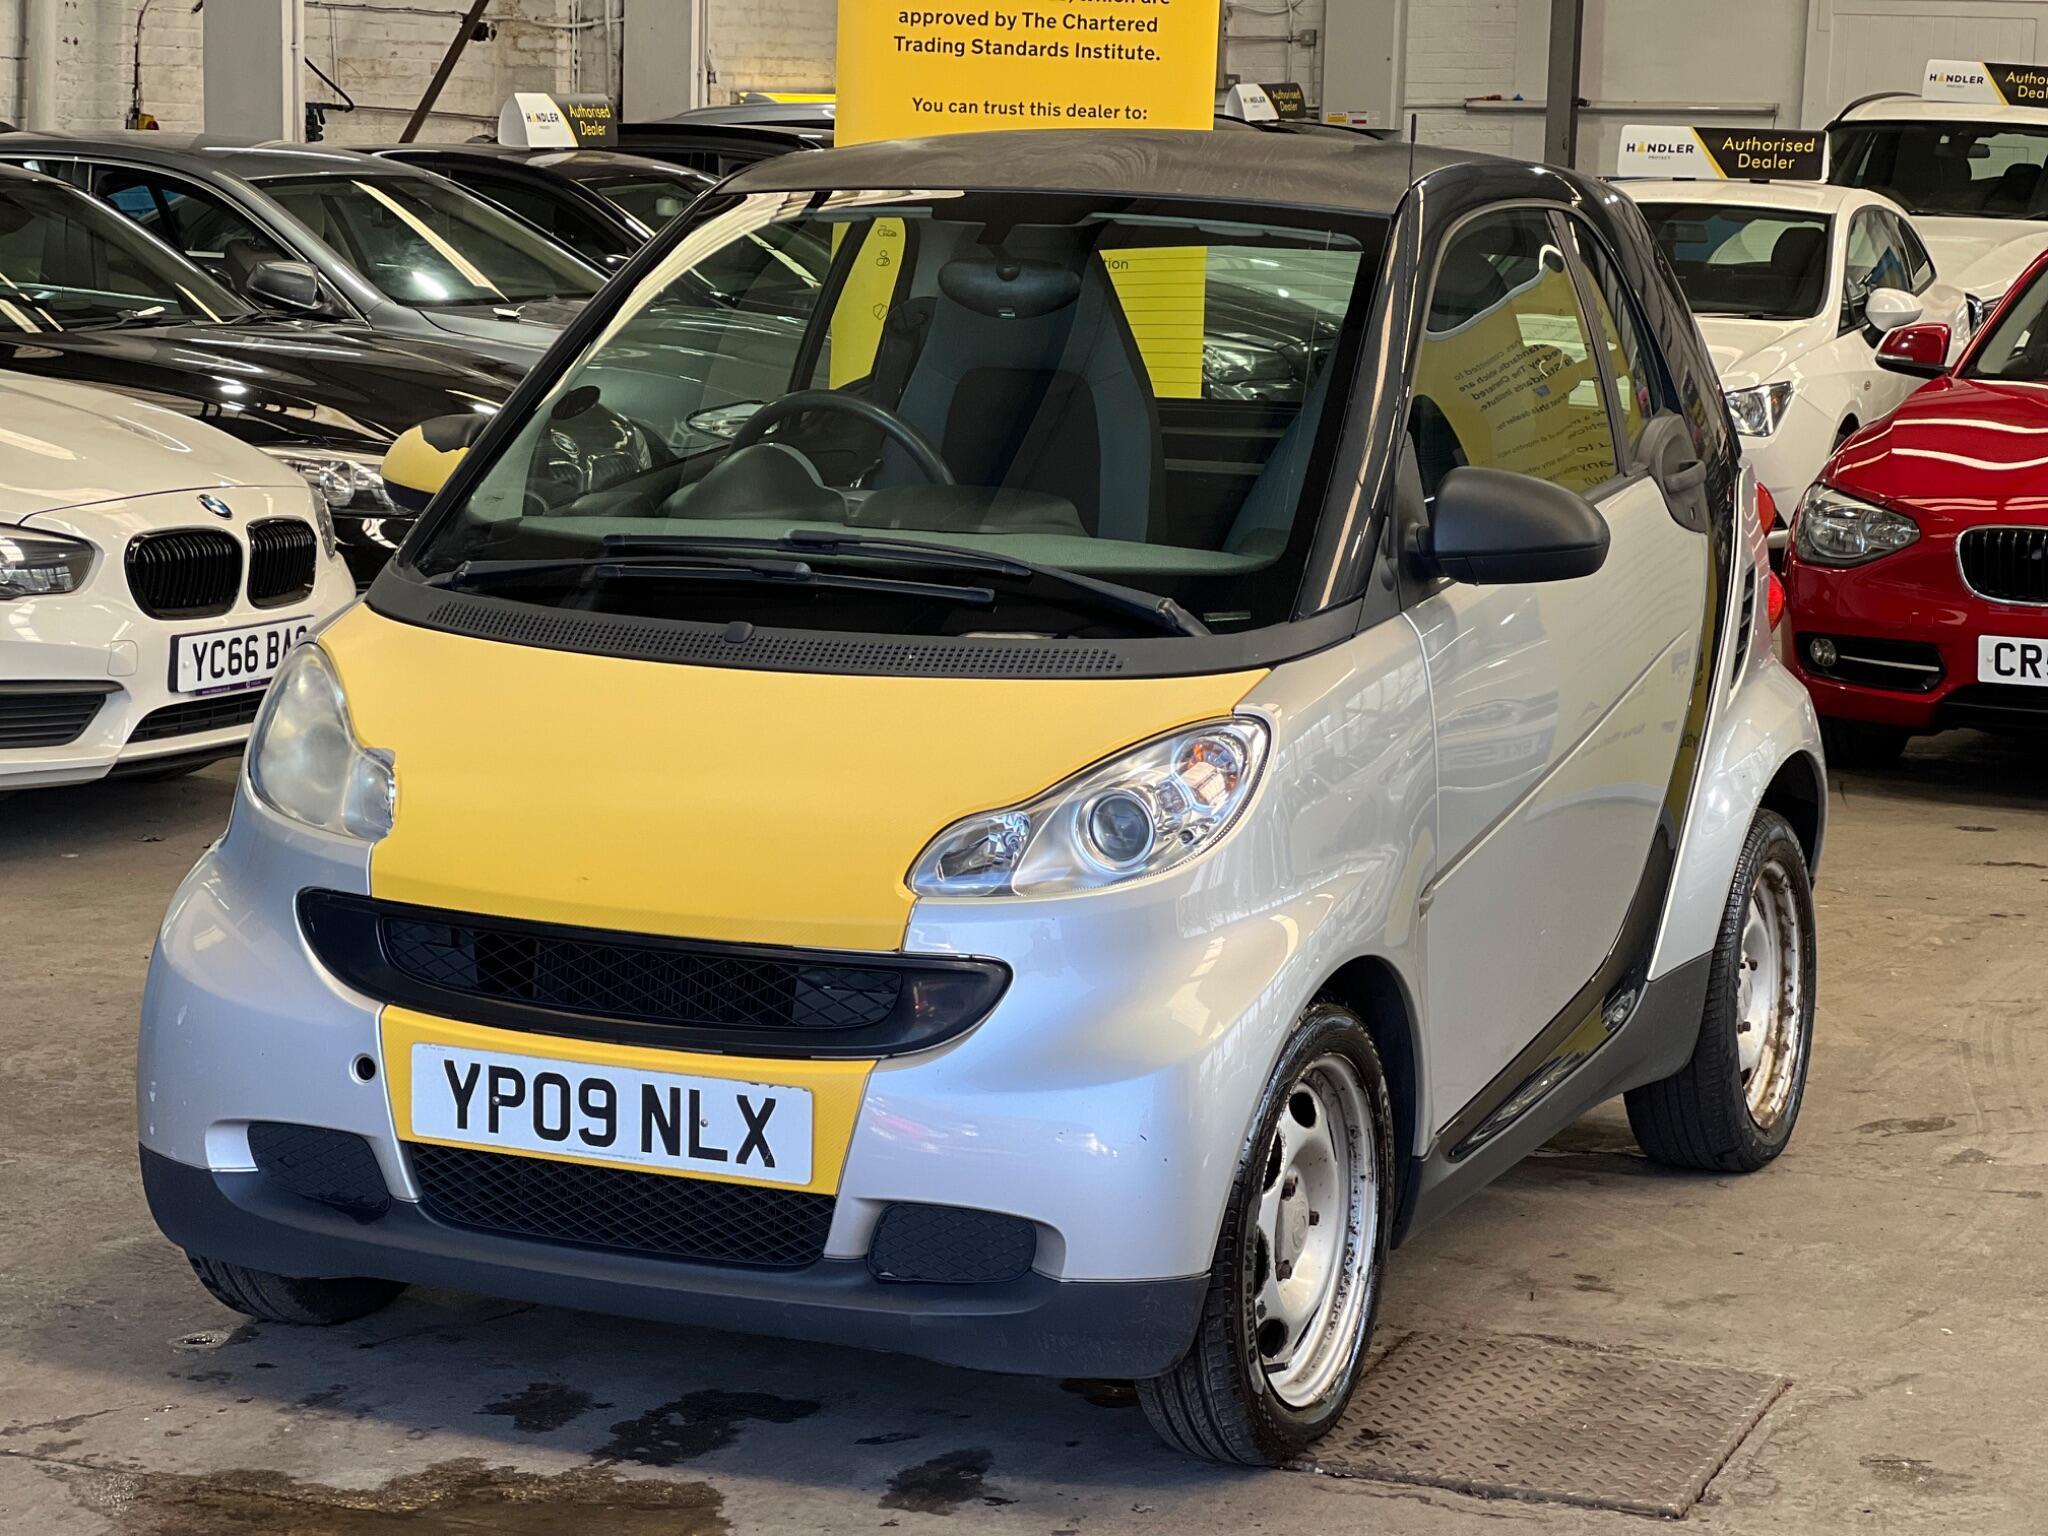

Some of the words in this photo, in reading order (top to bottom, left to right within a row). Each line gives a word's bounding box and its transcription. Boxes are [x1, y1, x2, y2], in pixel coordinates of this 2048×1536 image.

[898, 10, 989, 29] approved
[994, 11, 1018, 31] by
[1021, 12, 1057, 29] The
[1062, 13, 1158, 33] Chartered
[893, 35, 965, 58] Trading
[971, 38, 1070, 58] Standards
[1075, 42, 1161, 62] Institute.
[1928, 72, 1984, 85] HANDLER
[568, 103, 612, 119] Authorised
[911, 97, 943, 113] You
[948, 102, 978, 115] can
[983, 101, 1025, 117] trust
[1029, 102, 1061, 118] this
[1065, 103, 1121, 120] dealer
[1124, 105, 1148, 121] to:
[1279, 100, 1298, 112] Dealer
[526, 112, 560, 123] HANDLER
[579, 121, 607, 136] Dealer
[1626, 141, 1695, 154] HANDLER
[1721, 136, 1816, 154] Authorised
[1737, 153, 1796, 170] Dealer
[192, 634, 259, 682] YC66
[1994, 642, 2048, 679] CR
[443, 1058, 617, 1149] YP09
[640, 1083, 777, 1169] NLX
